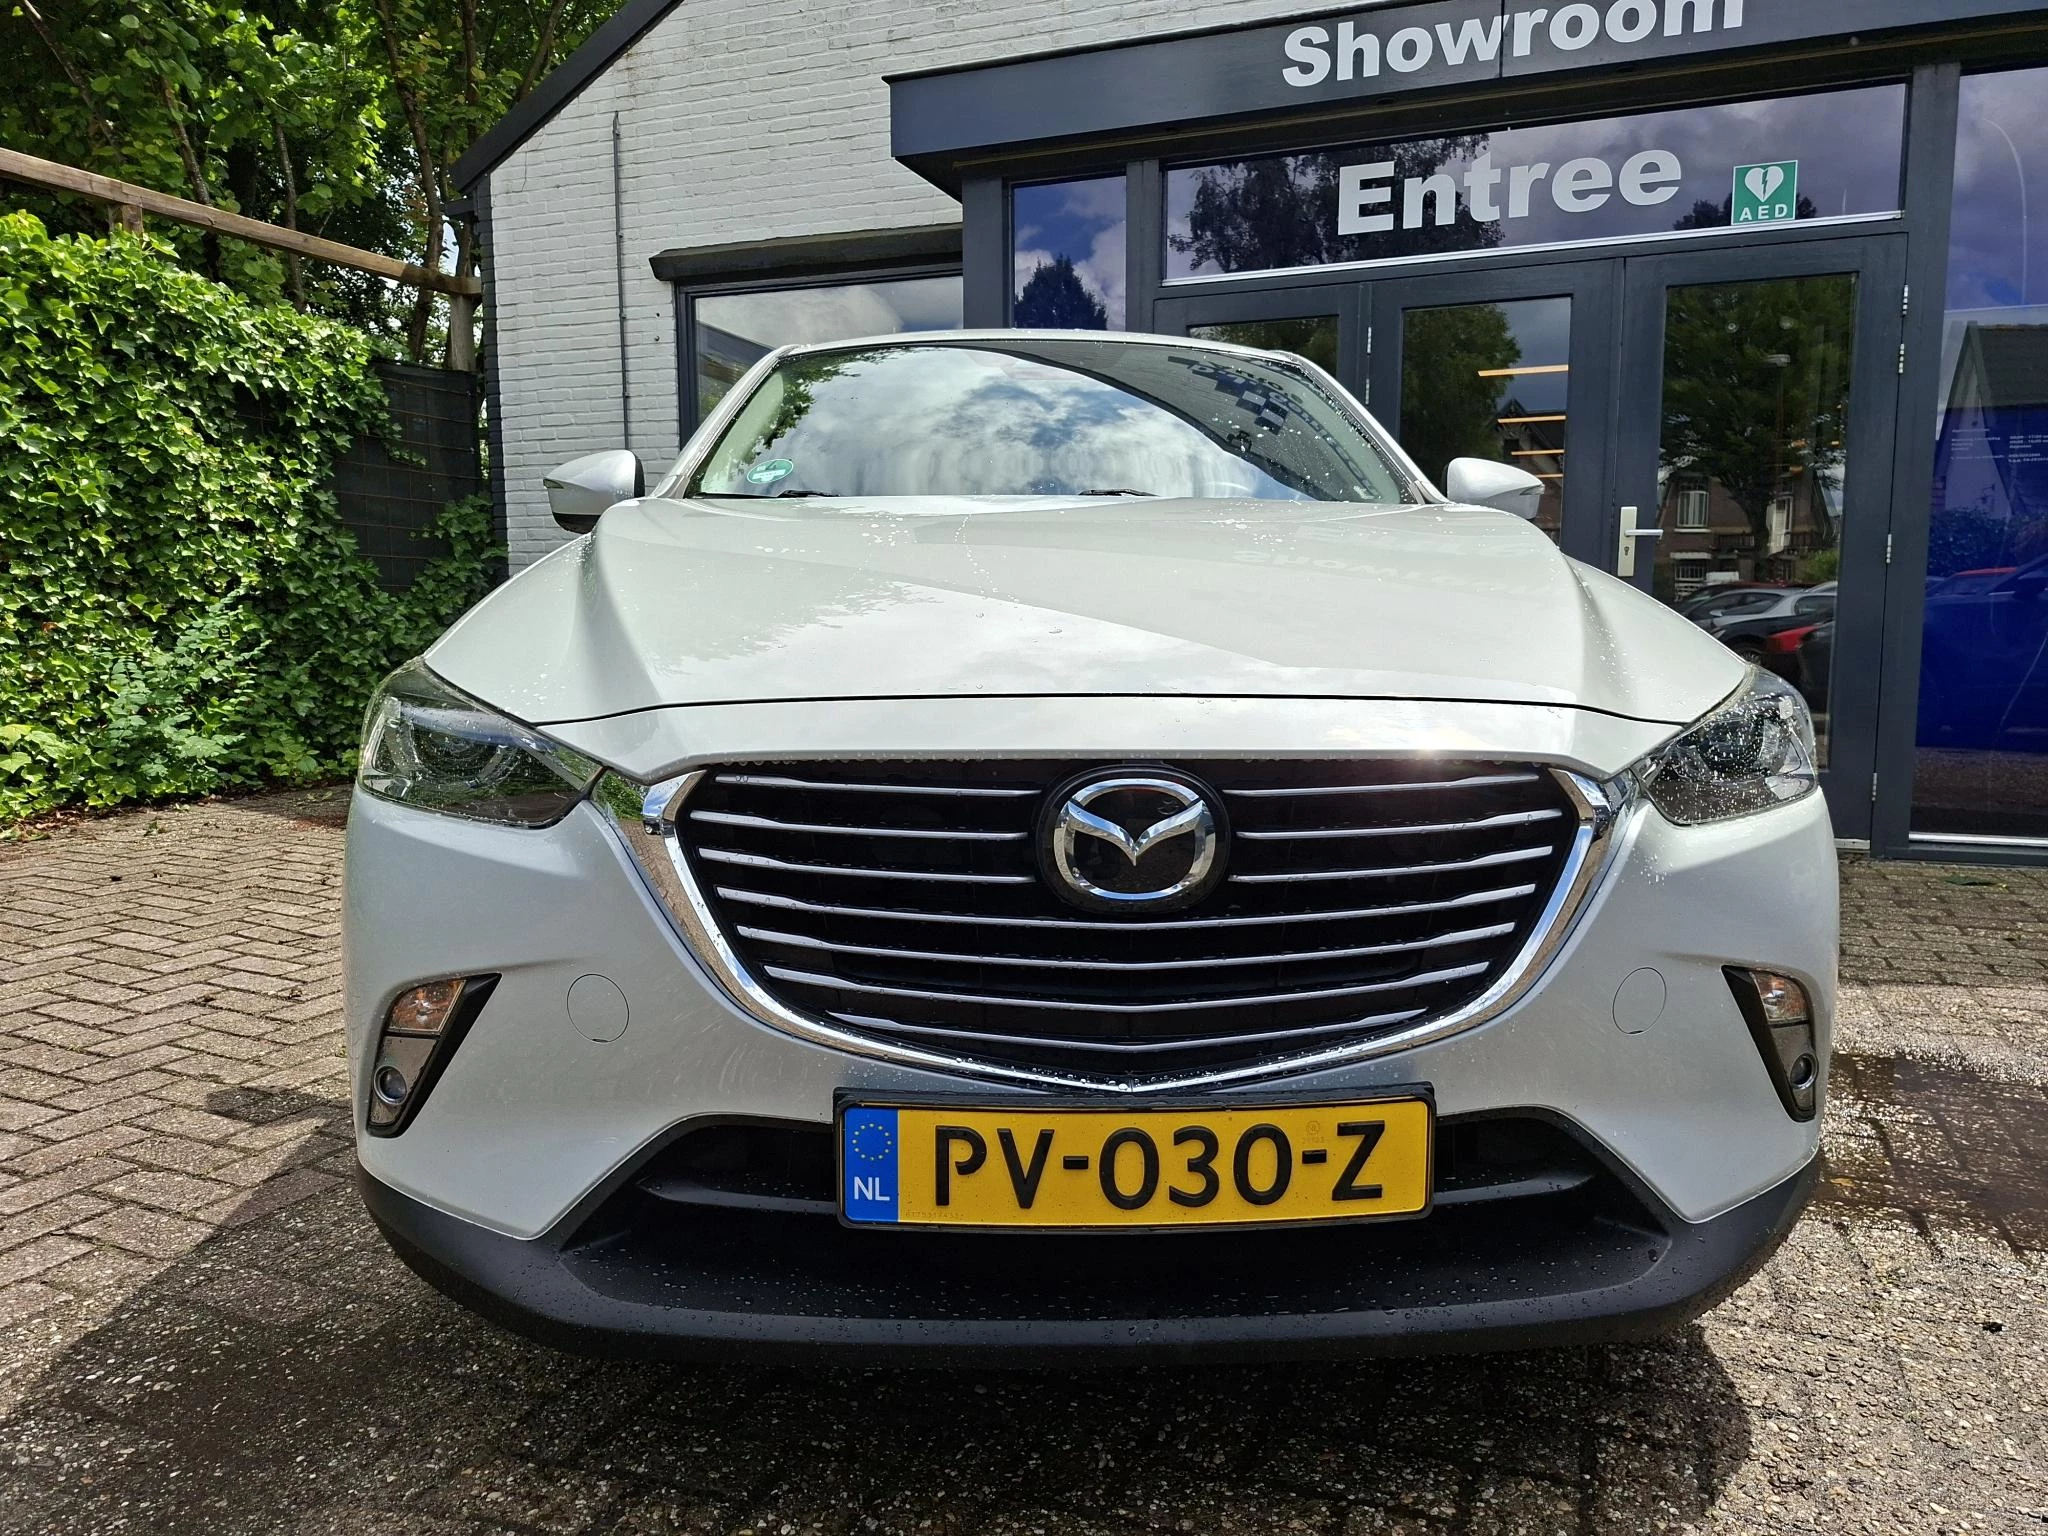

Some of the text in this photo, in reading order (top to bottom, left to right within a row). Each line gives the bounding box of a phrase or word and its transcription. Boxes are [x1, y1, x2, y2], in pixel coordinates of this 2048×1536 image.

[1282, 0, 1744, 87] Showroom
[1338, 149, 1682, 236] Entree
[1739, 203, 1788, 222] AED
[853, 1120, 1387, 1210] NL PV-030-Z
